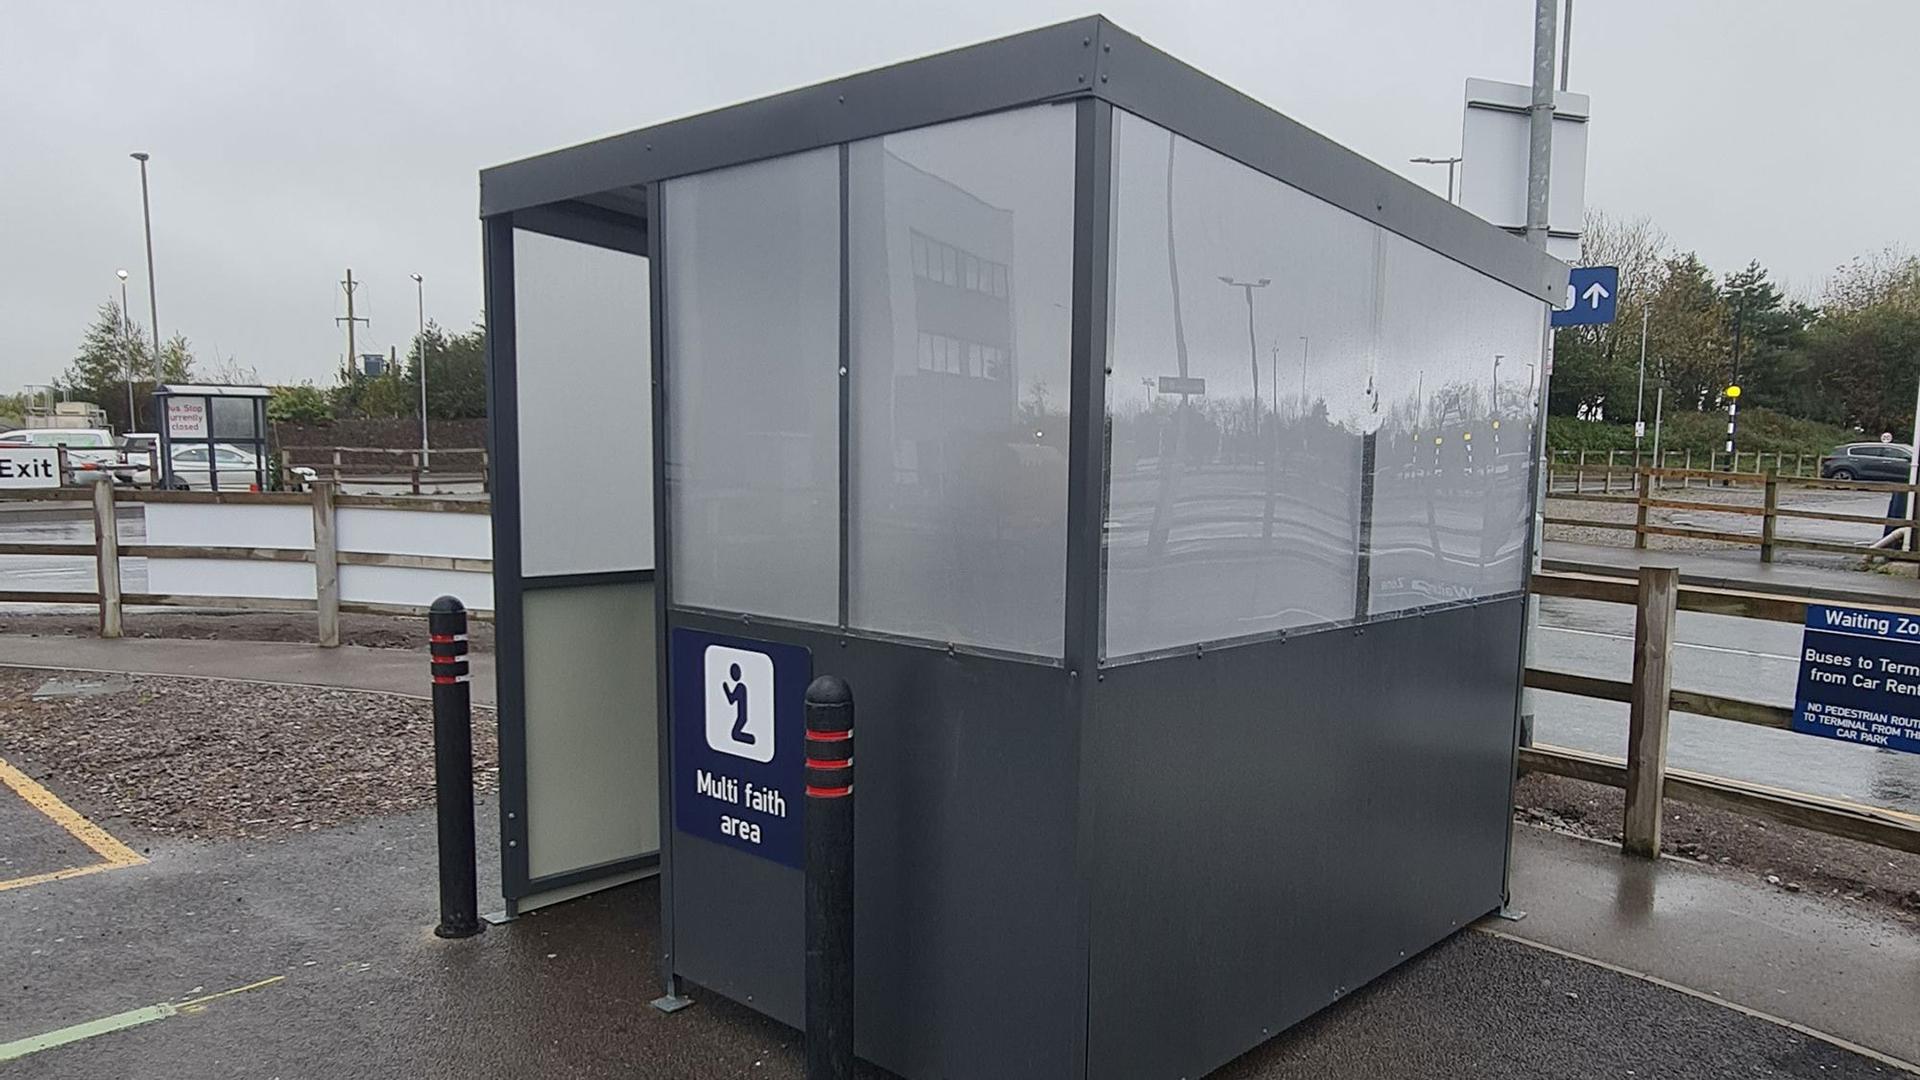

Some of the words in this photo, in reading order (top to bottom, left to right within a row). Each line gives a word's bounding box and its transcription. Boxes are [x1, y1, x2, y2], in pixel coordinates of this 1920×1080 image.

[169, 414, 203, 423] urrently
[184, 404, 203, 413] Stop
[172, 423, 199, 431] closed
[0, 459, 53, 478] Exit
[1825, 609, 1889, 634] Waiting
[1896, 618, 1920, 634] Zo
[1805, 648, 1852, 667] Buses
[1858, 656, 1873, 669] to
[1879, 658, 1920, 677] Term
[1810, 668, 1846, 685] from
[1852, 674, 1880, 690] Car
[1807, 702, 1822, 713] NO
[1824, 704, 1888, 724] PEDESTRIAN
[1803, 712, 1816, 722] TO
[1819, 714, 1869, 732] TERMINAL
[1871, 723, 1901, 737] FROM
[1836, 728, 1857, 740] CAR
[1860, 731, 1889, 745] PARK
[696, 769, 738, 804] Multi
[745, 783, 786, 818] faith
[720, 815, 761, 844] area
